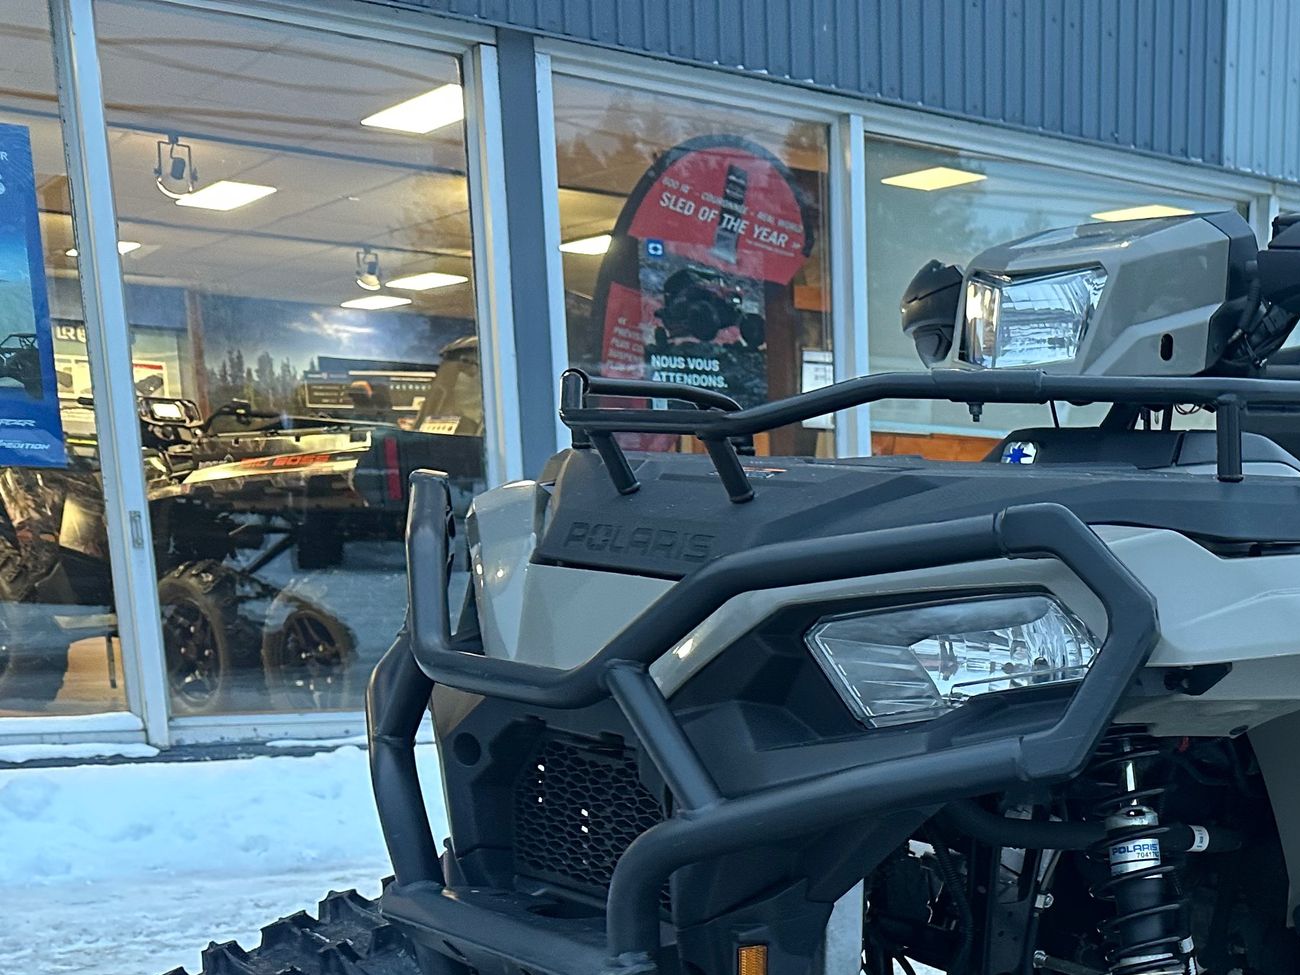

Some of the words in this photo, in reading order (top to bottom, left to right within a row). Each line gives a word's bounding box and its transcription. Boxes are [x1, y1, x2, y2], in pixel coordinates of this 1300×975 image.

[660, 192, 696, 217] SLED
[698, 206, 719, 223] OF
[720, 213, 750, 235] THE
[753, 224, 790, 248] YEAR
[650, 354, 686, 369] NOUS
[687, 357, 720, 372] VOUS
[651, 371, 729, 388] ATTENDONS.
[563, 521, 716, 562] POLARIS
[1111, 843, 1159, 856] POLARIS
